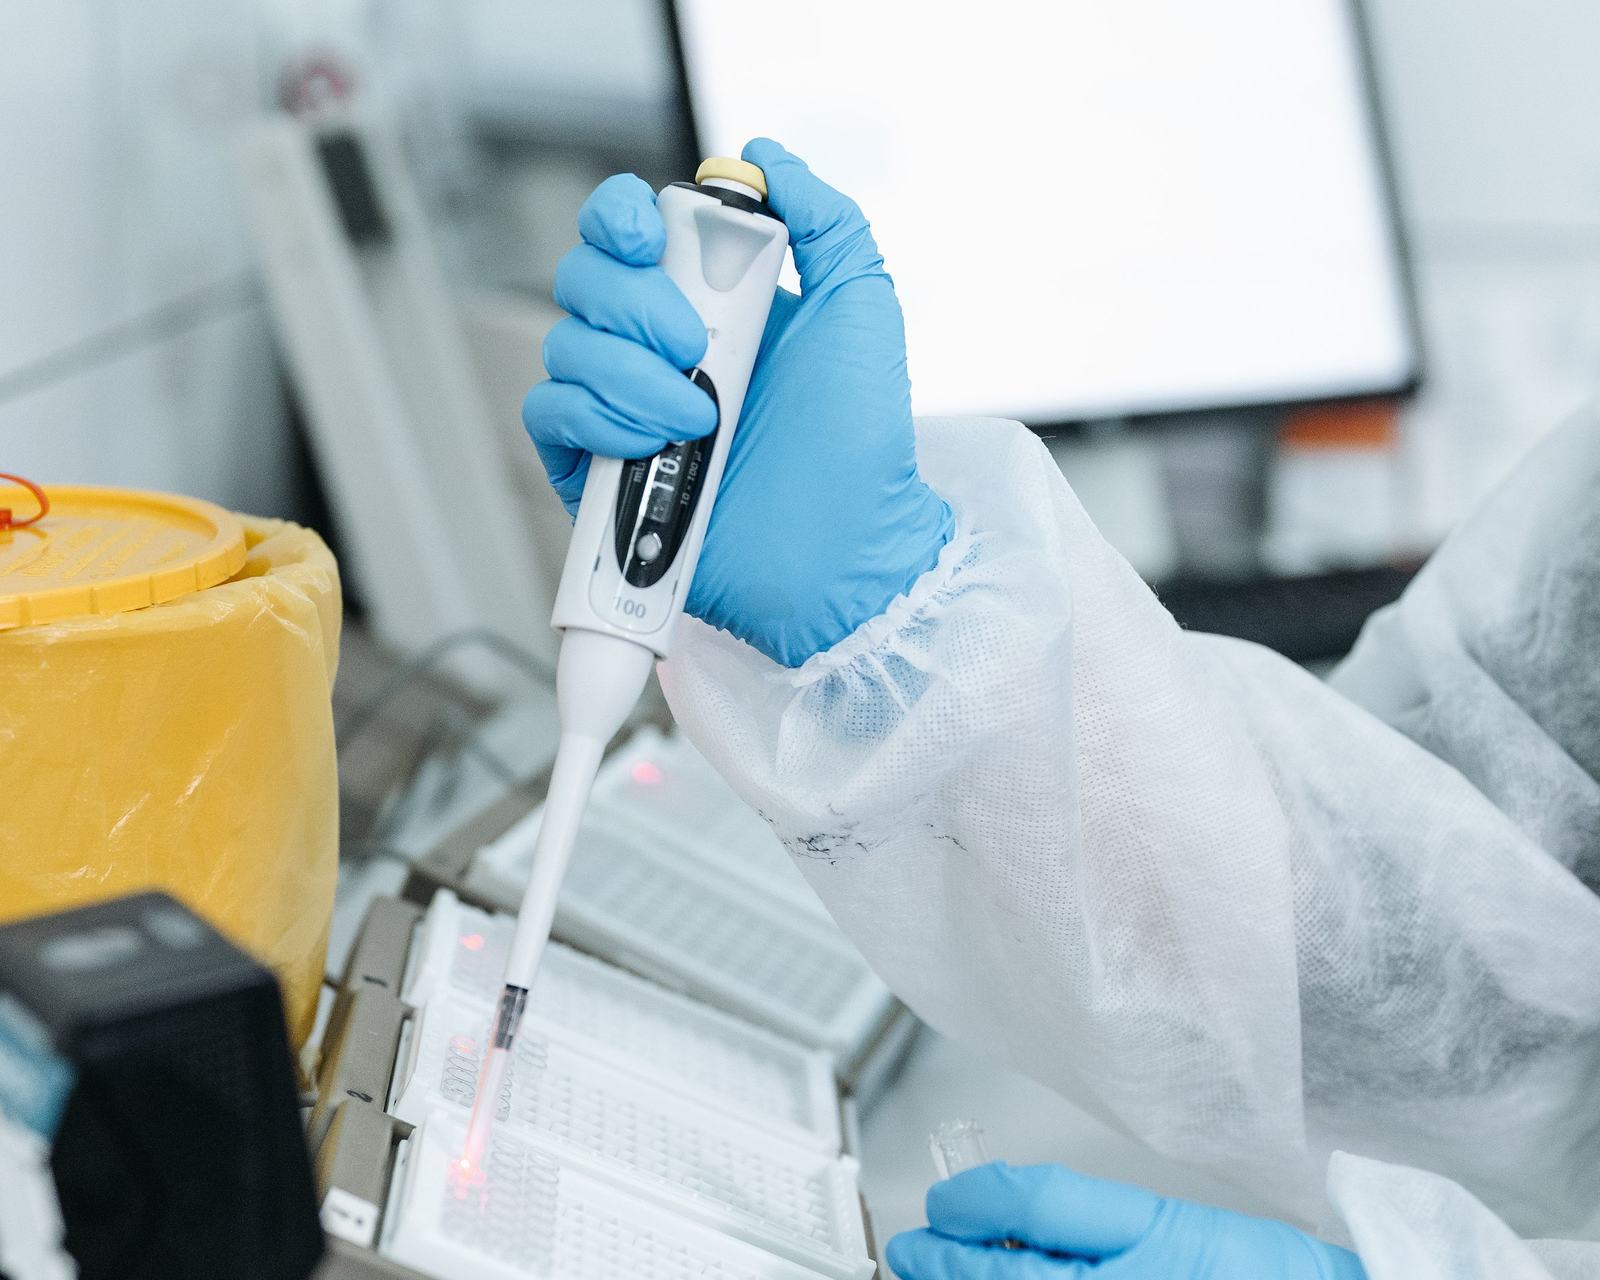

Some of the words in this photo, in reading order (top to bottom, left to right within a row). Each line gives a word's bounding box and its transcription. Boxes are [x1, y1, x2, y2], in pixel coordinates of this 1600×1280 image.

[680, 492, 690, 506] 10
[687, 462, 698, 481] 100
[613, 596, 646, 618] 100
[346, 1088, 374, 1103] 2
